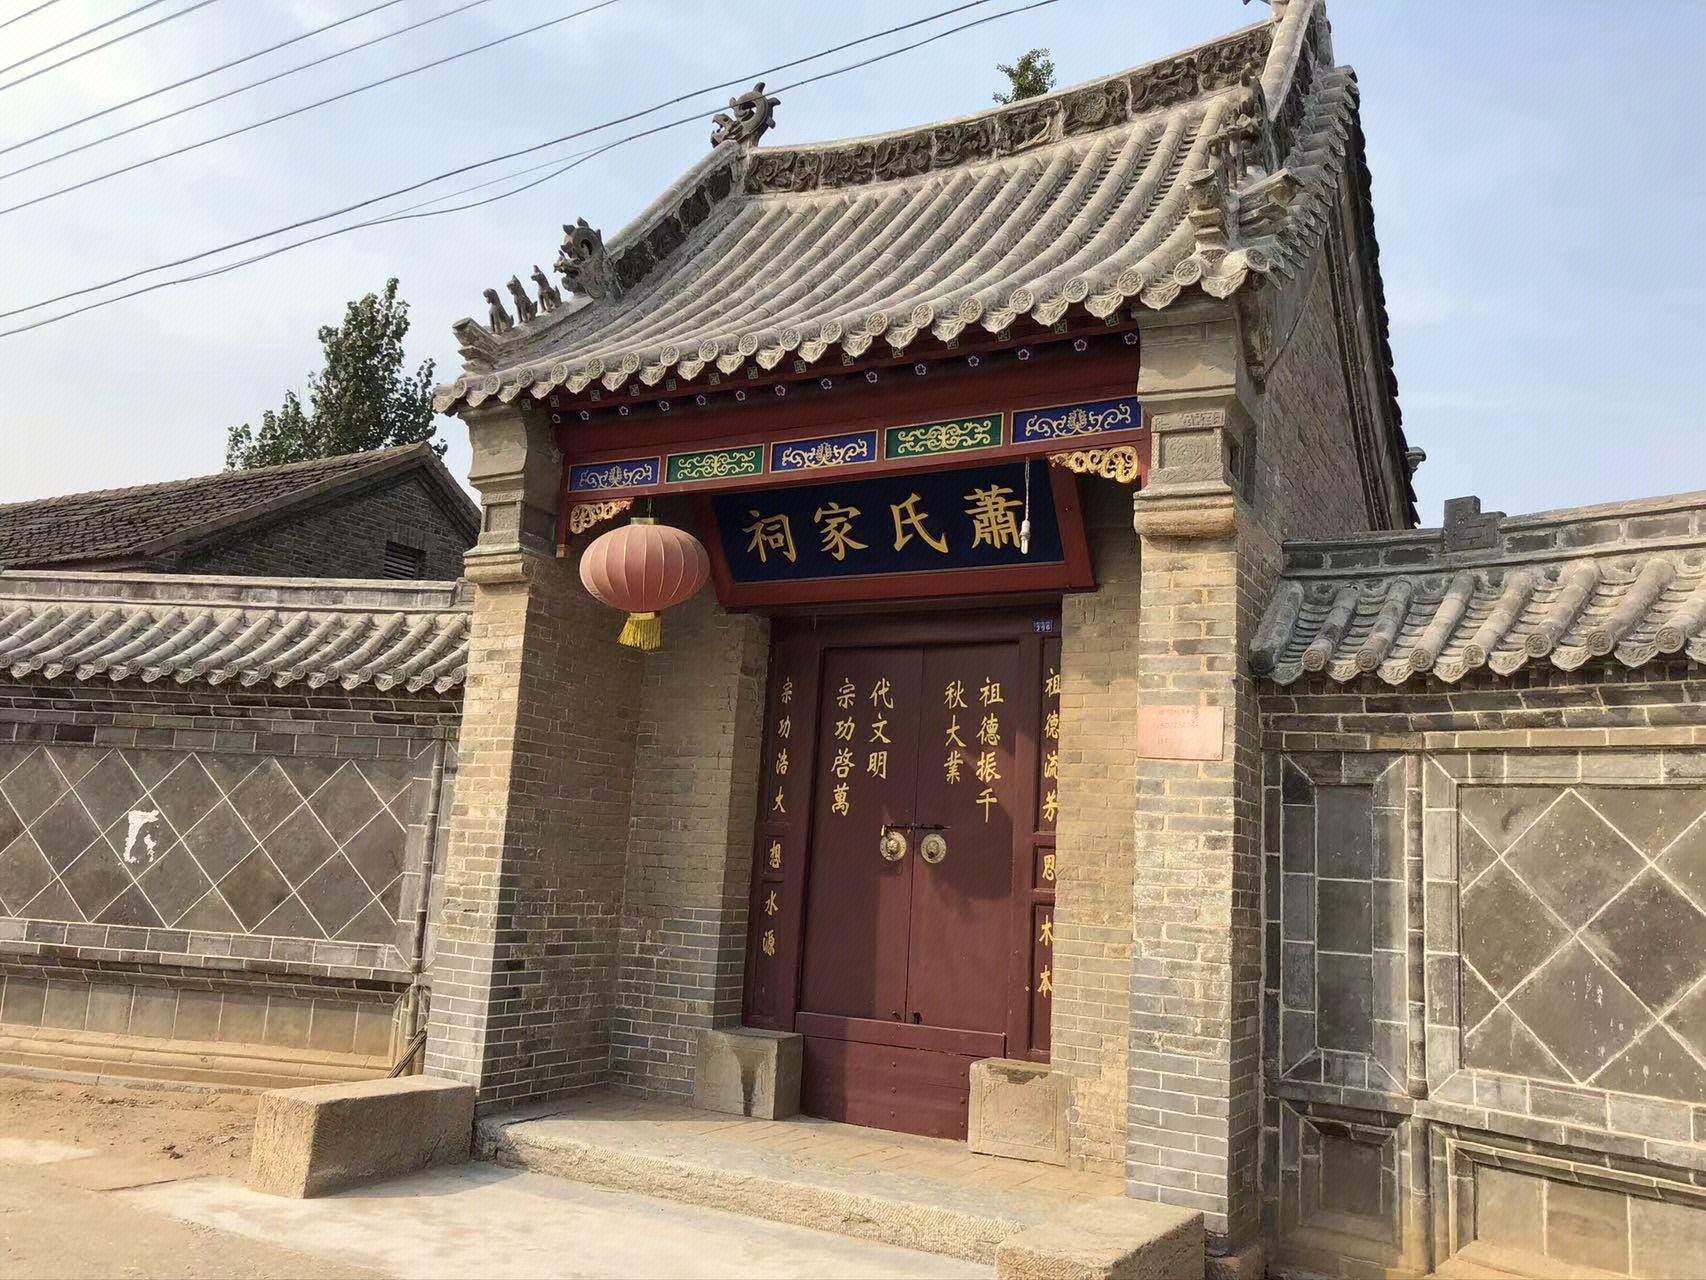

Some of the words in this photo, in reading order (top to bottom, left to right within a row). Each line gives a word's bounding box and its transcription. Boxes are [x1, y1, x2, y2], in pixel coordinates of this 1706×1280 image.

[742, 484, 1023, 562] 蕭氏家祠
[866, 677, 894, 779] 代文明
[943, 680, 968, 784] 秋大業
[975, 676, 1004, 823] 祖德振千
[762, 676, 793, 957] 宗功浩大想水源
[1037, 668, 1061, 998] 祖德流芳思木本
